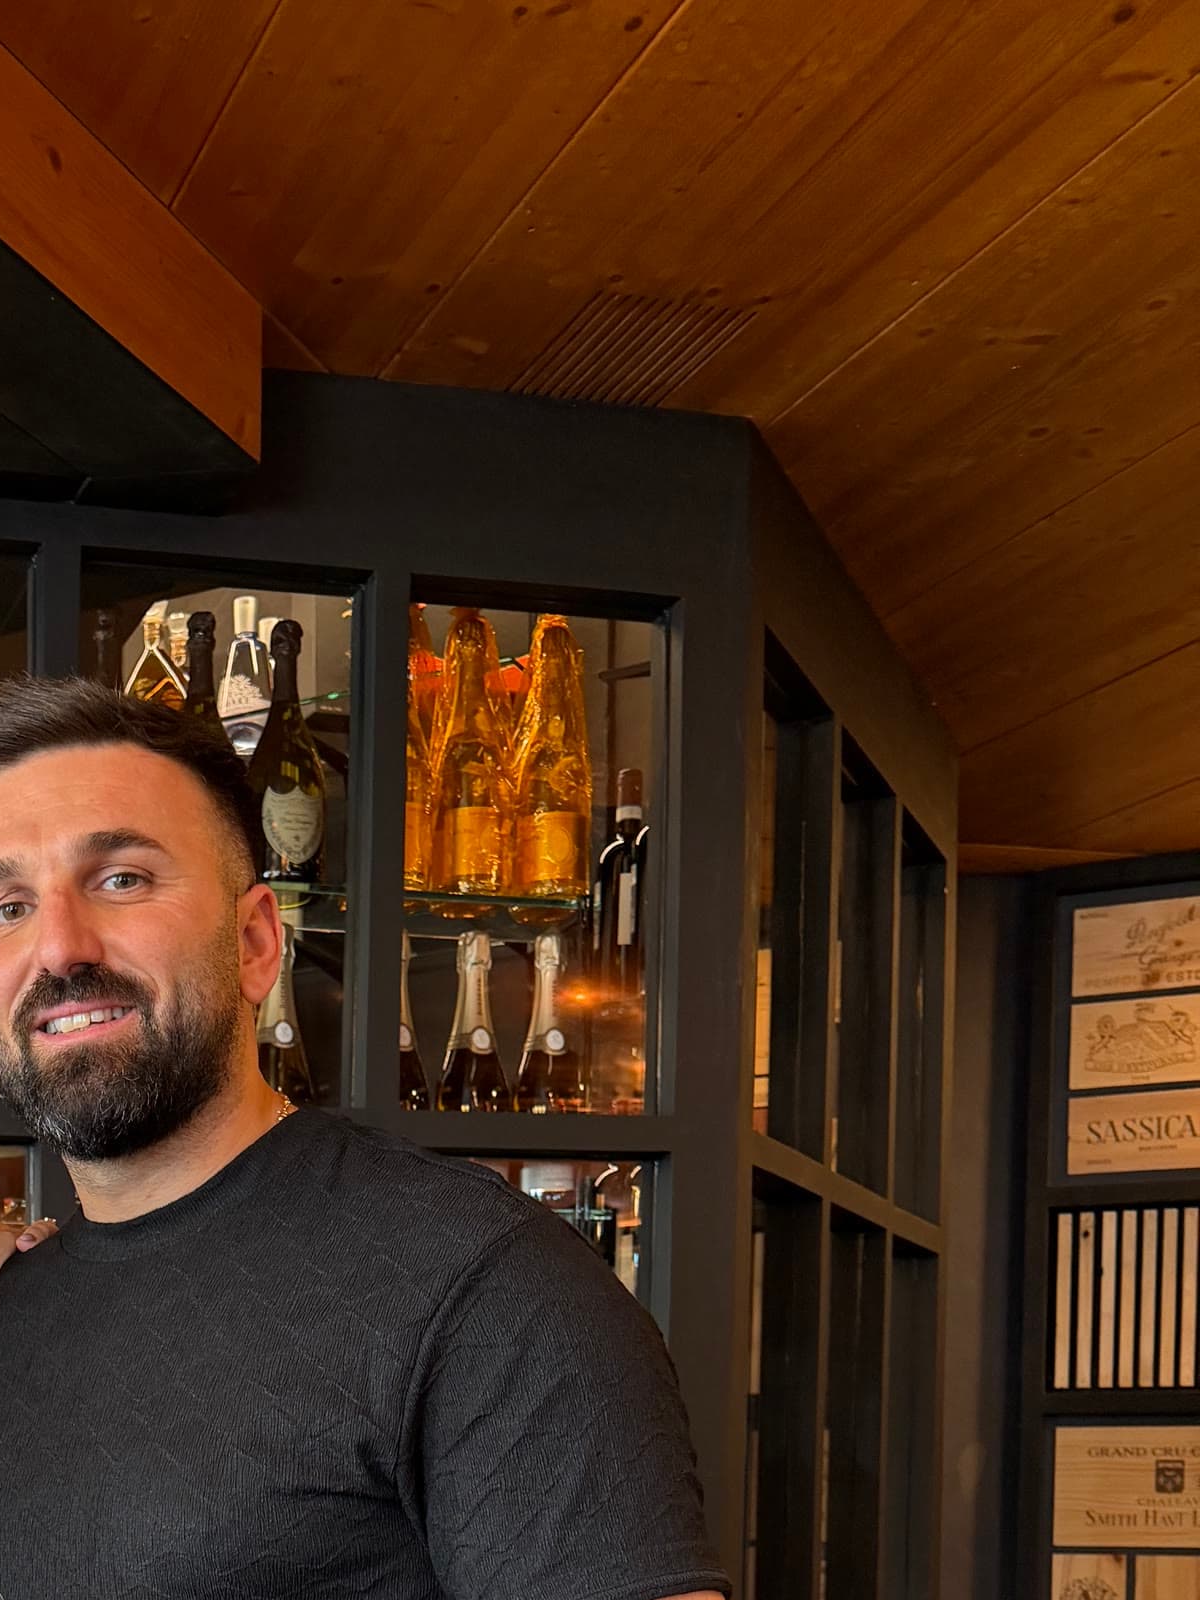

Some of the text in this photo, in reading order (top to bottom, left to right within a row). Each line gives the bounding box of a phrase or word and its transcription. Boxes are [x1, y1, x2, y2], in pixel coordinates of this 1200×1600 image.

[1086, 1114, 1199, 1144] SASSICA
[1087, 1446, 1147, 1458] GRAND
[1150, 1446, 1187, 1457] CRU
